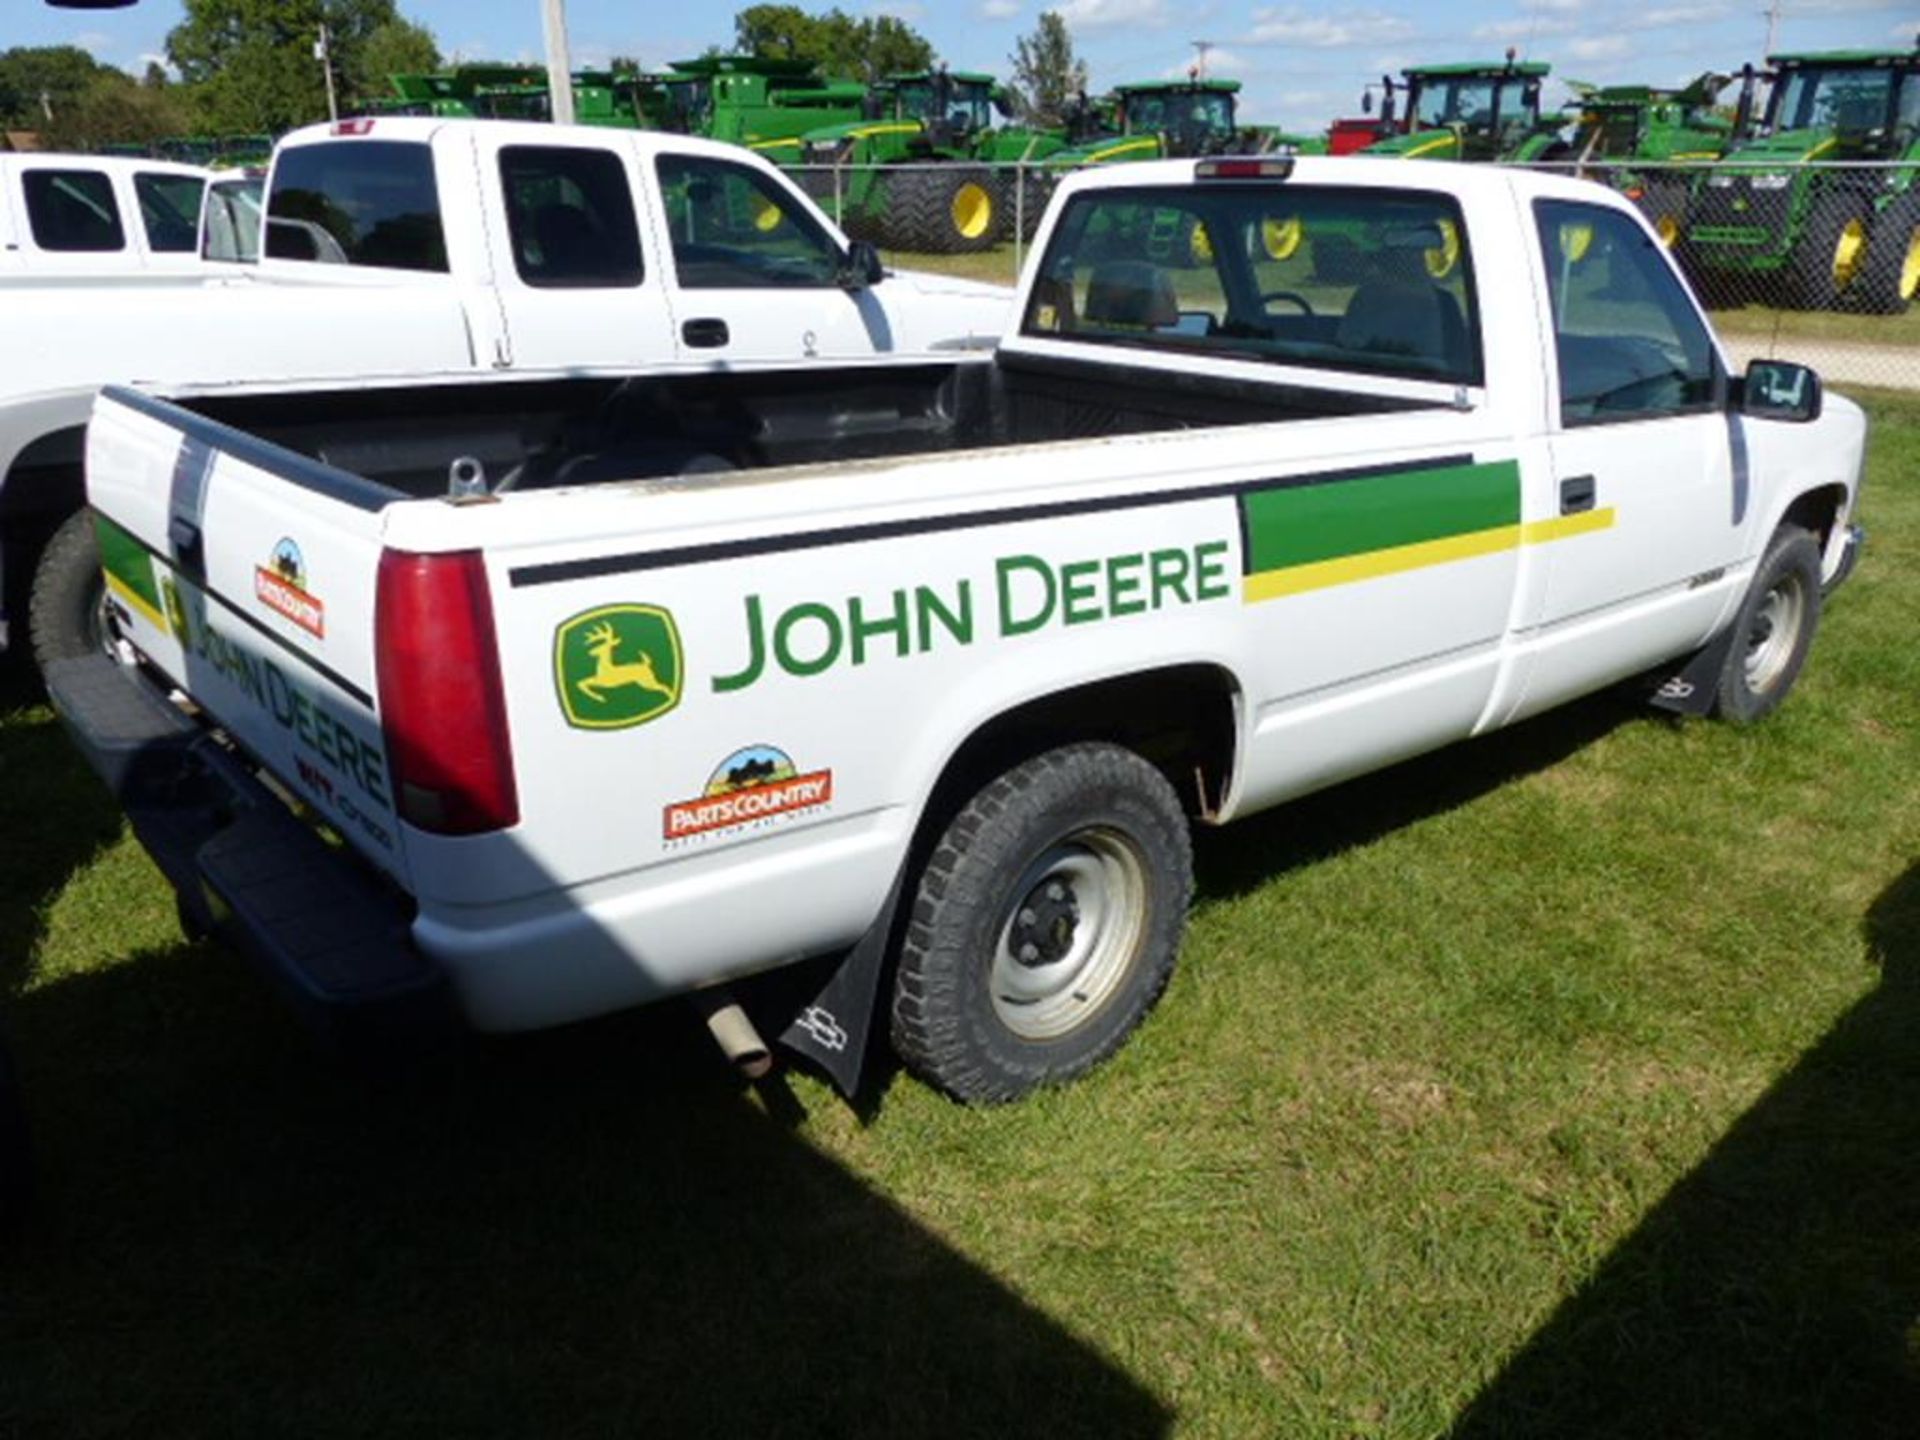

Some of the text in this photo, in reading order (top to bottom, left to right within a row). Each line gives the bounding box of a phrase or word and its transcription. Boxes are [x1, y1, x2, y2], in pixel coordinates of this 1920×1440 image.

[711, 540, 1230, 693] JOHN DEERE
[263, 656, 391, 810] DEERE
